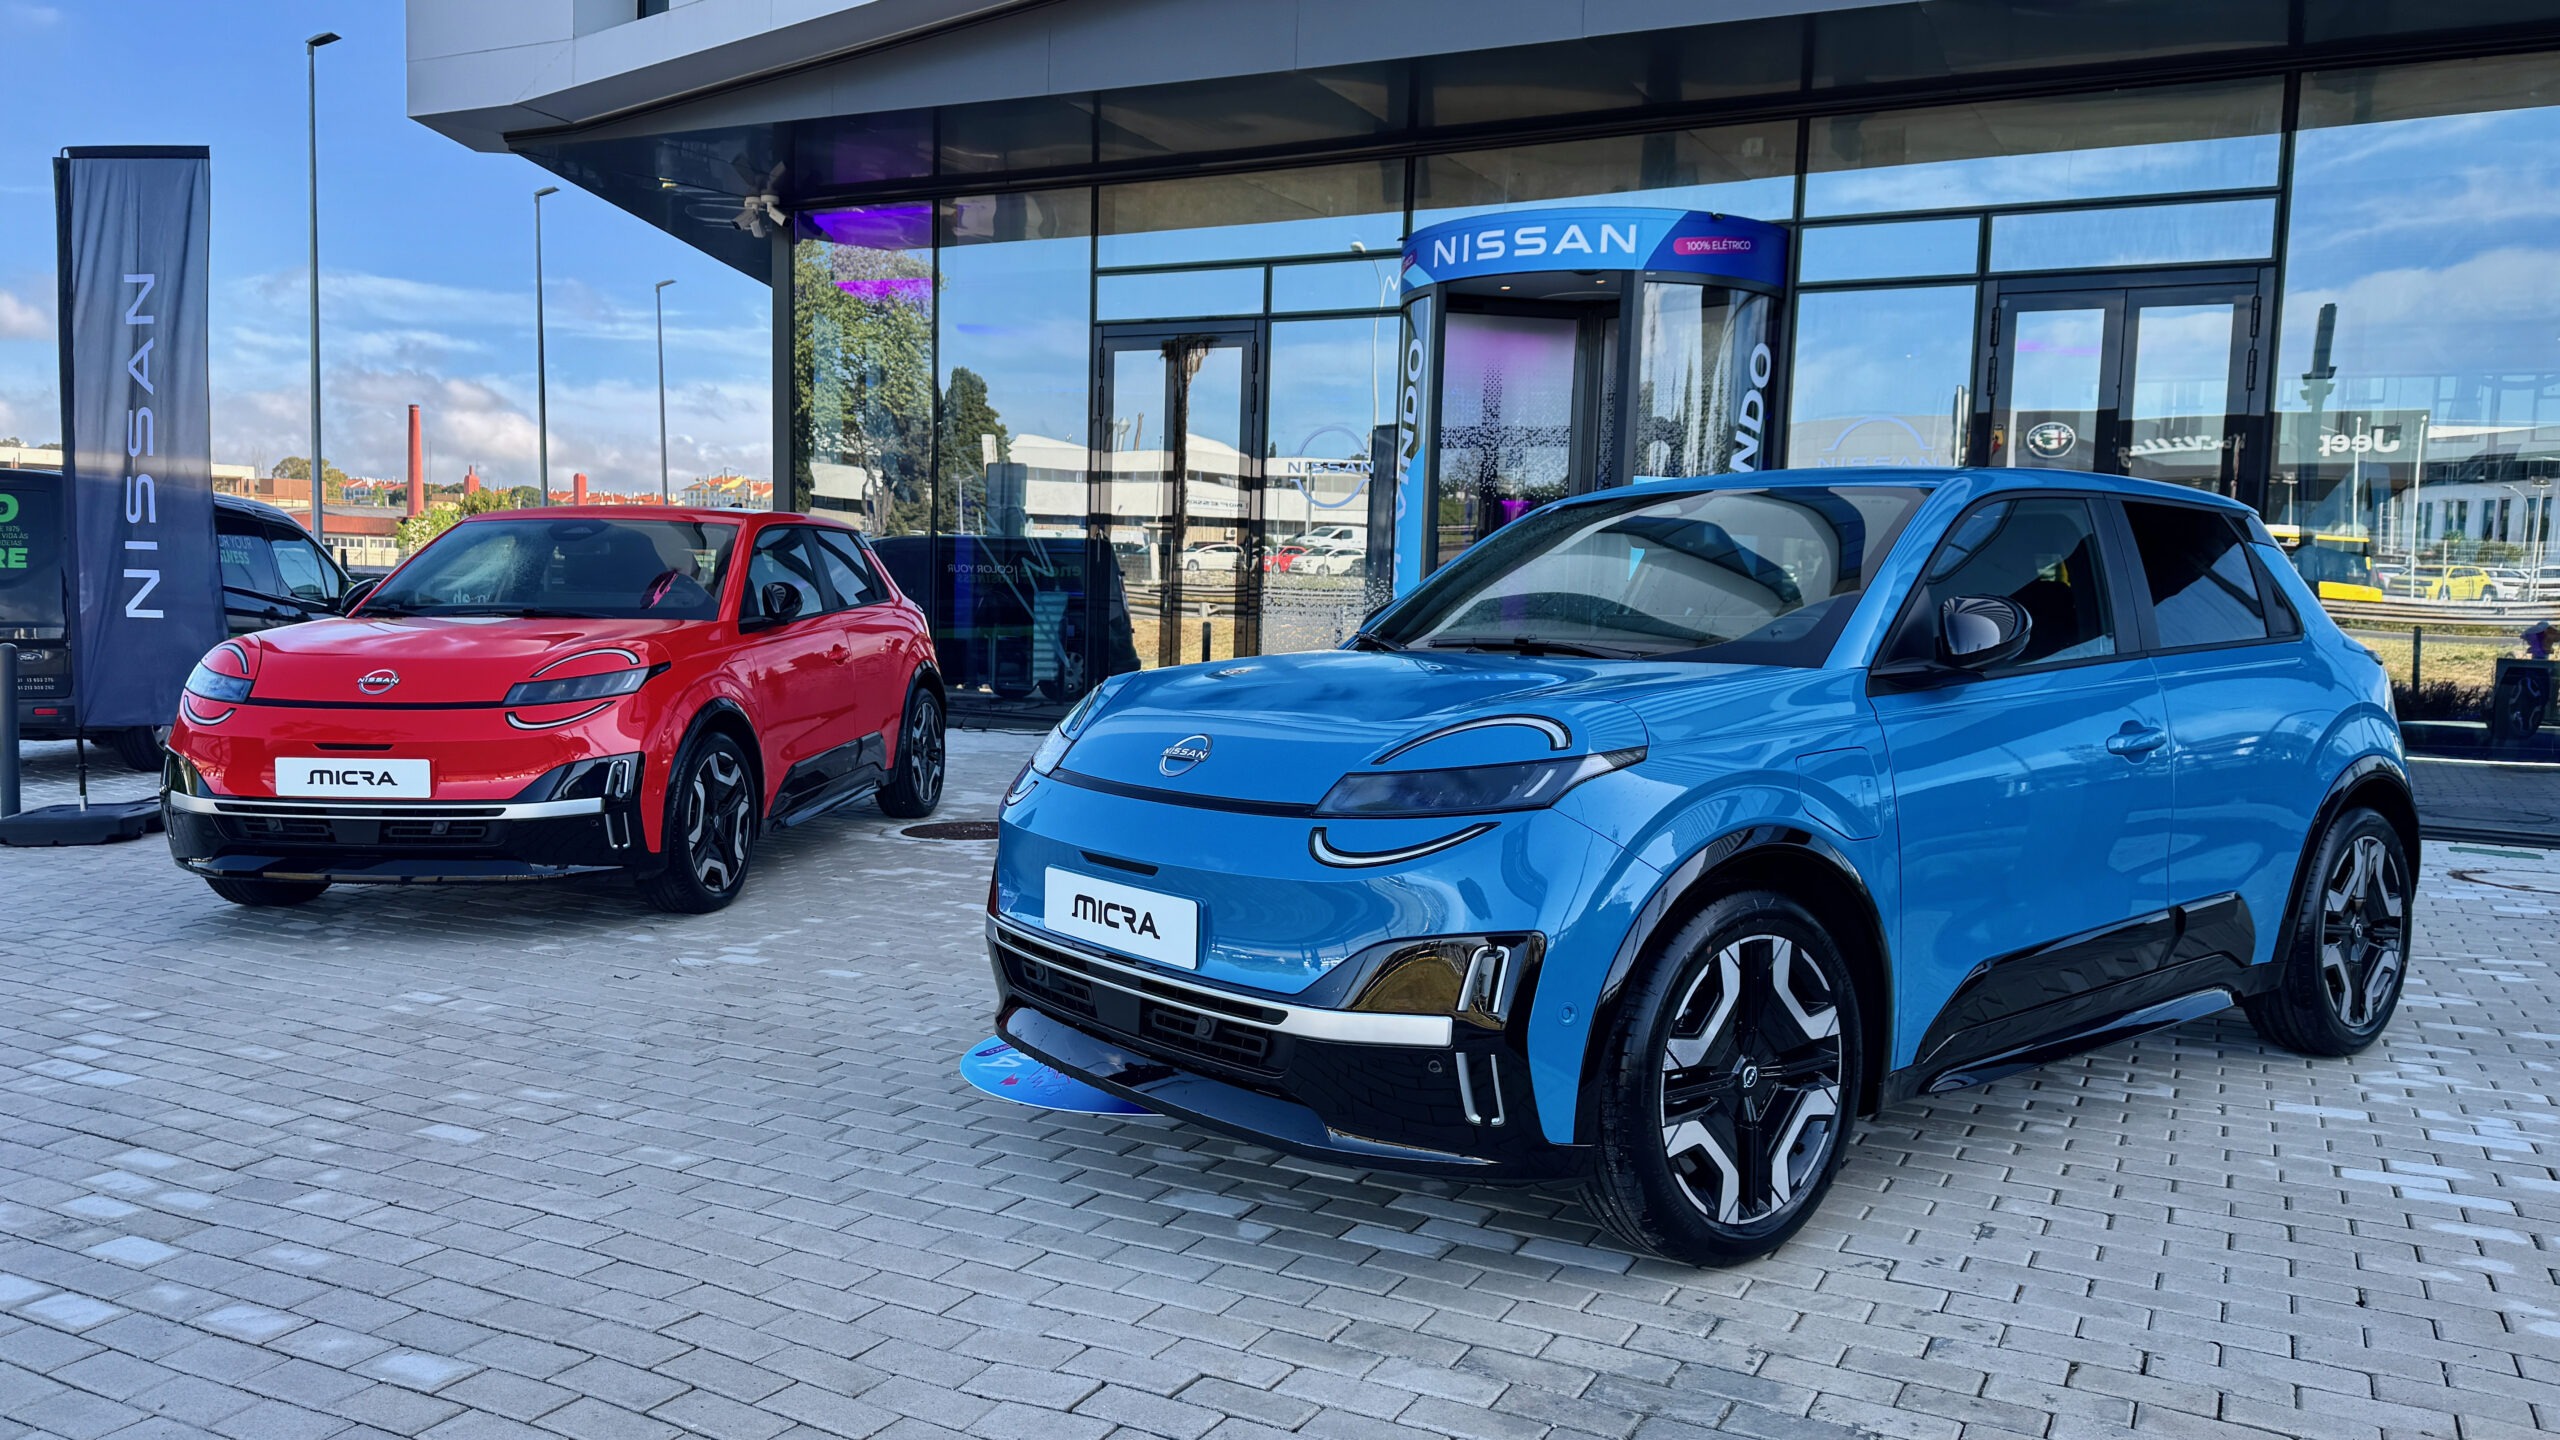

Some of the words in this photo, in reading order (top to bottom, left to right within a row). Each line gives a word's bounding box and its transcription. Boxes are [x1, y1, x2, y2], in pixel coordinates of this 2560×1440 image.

[1433, 224, 1637, 268] NISSAN
[1686, 241, 1711, 251] 100%
[1711, 238, 1752, 251] ELÉTRICO
[123, 273, 164, 619] NISSAN
[1287, 461, 1375, 474] NISSAN
[1162, 746, 1208, 760] NISSAN
[307, 769, 398, 786] MICRA
[1071, 893, 1161, 940] MICRA
